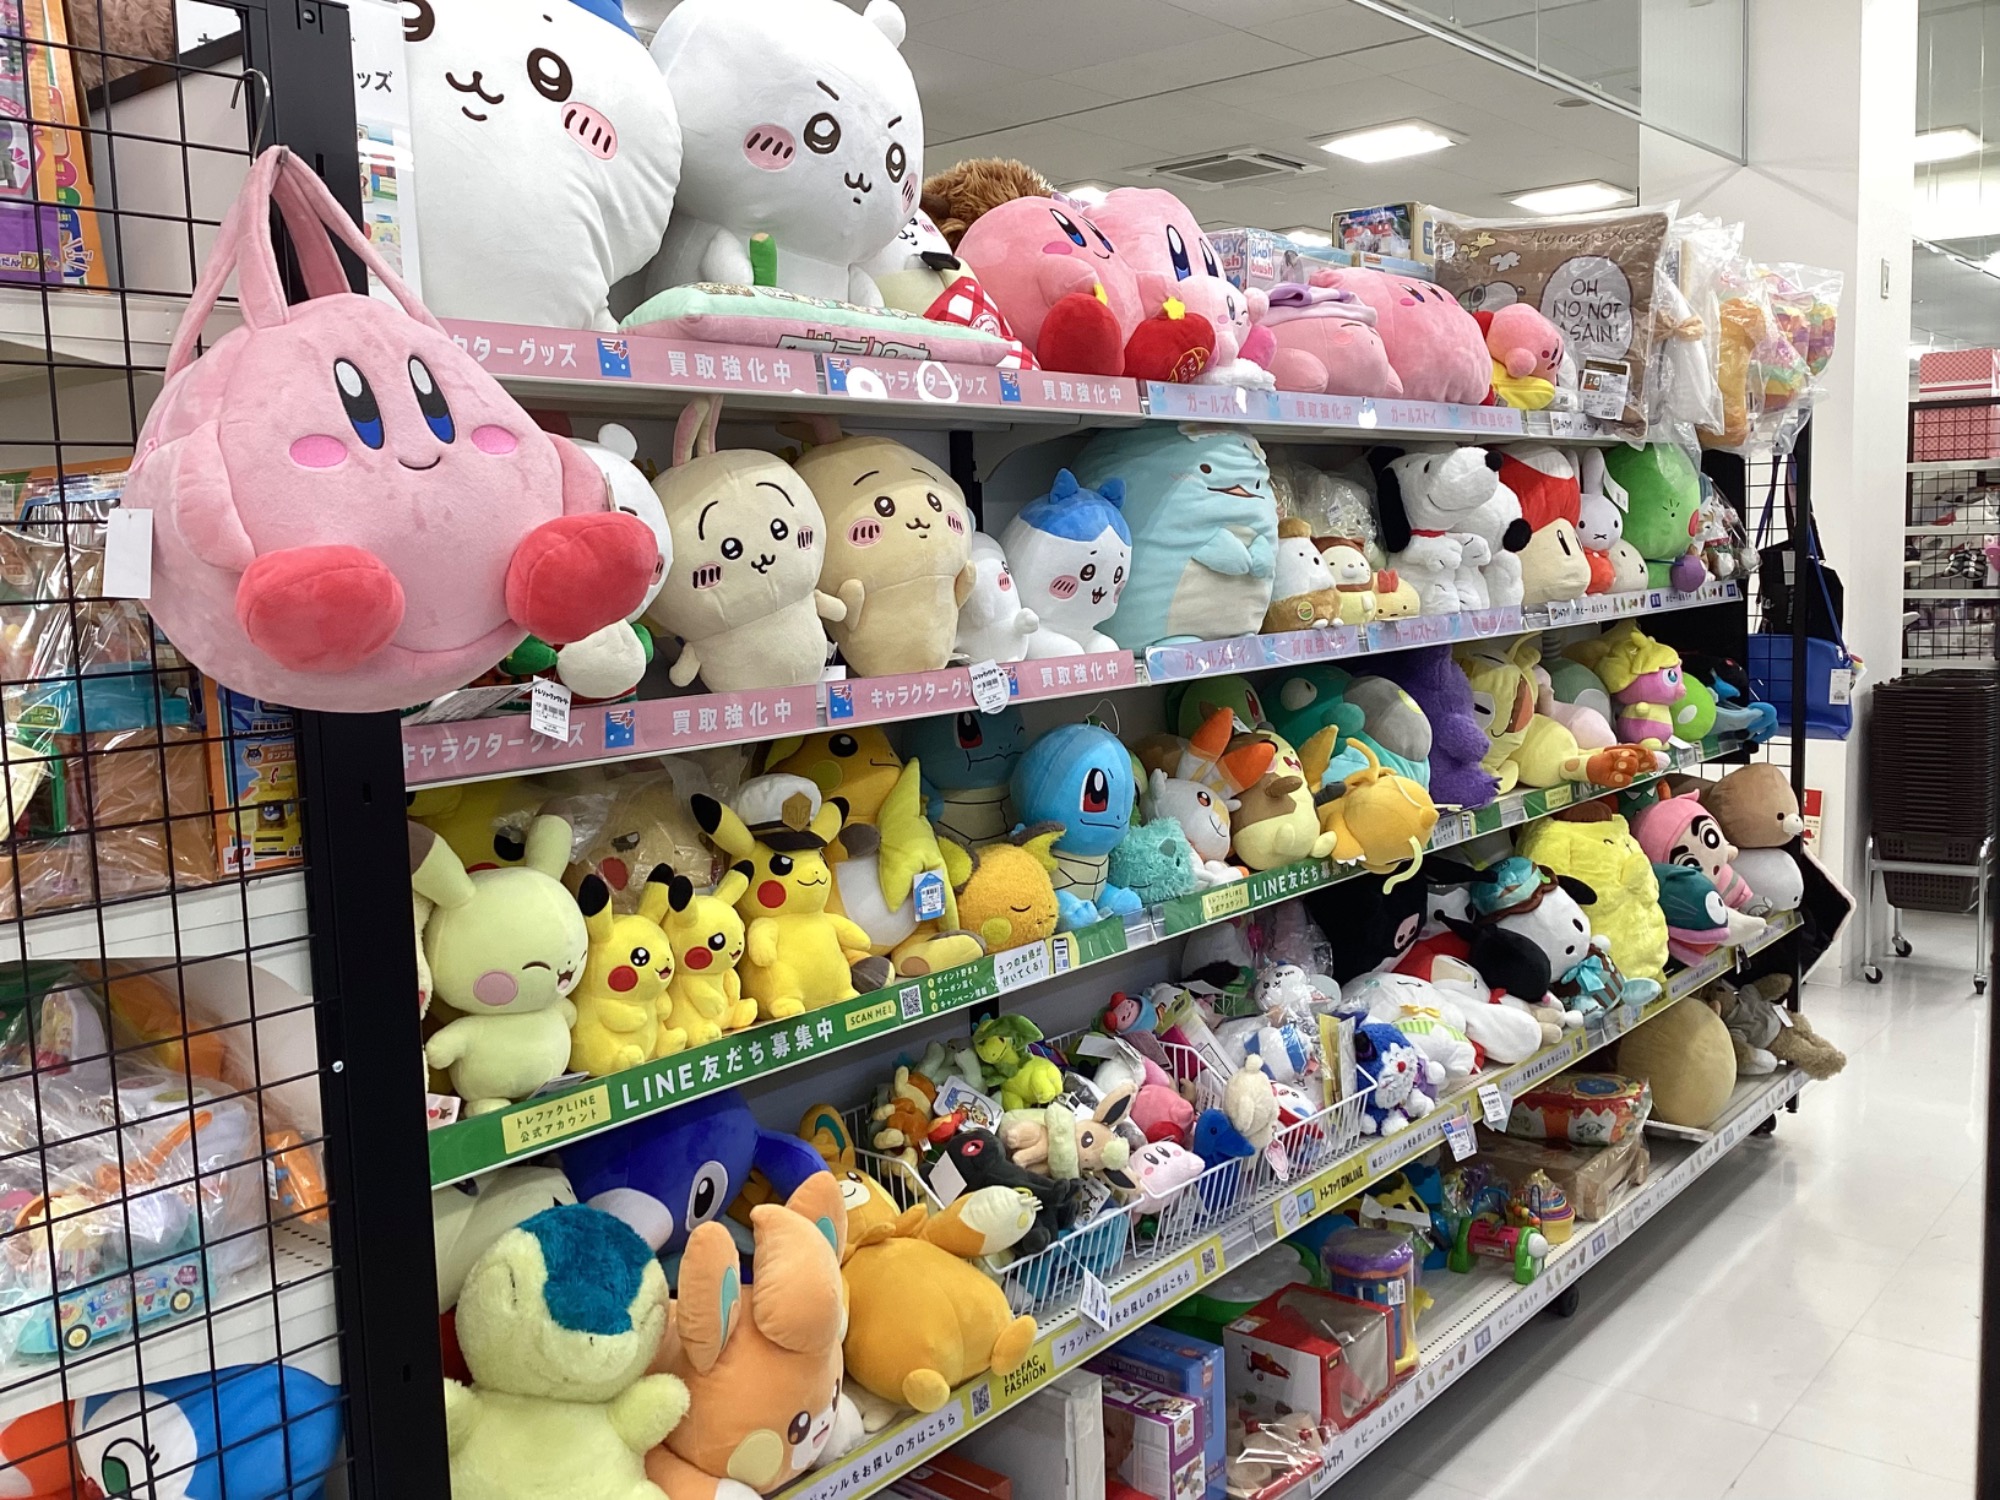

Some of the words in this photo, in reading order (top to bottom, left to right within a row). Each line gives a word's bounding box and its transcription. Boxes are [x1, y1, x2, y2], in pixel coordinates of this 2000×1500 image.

[1570, 278, 1604, 302] OH,
[1553, 299, 1584, 323] NO,
[1587, 302, 1622, 320] NOT
[667, 350, 792, 385] 買取強化中
[1042, 380, 1122, 405] 買取強化中
[1040, 659, 1119, 688] 買取強化中
[672, 699, 792, 736] 買取強化中
[850, 1010, 874, 1025] SCAN
[875, 1004, 892, 1018] ME!
[621, 1016, 835, 1110] LINE友だち募集中
[516, 1094, 597, 1129] トレファクLINE
[520, 1109, 597, 1143] 公式アカウント
[1004, 1362, 1046, 1398] FASHION
